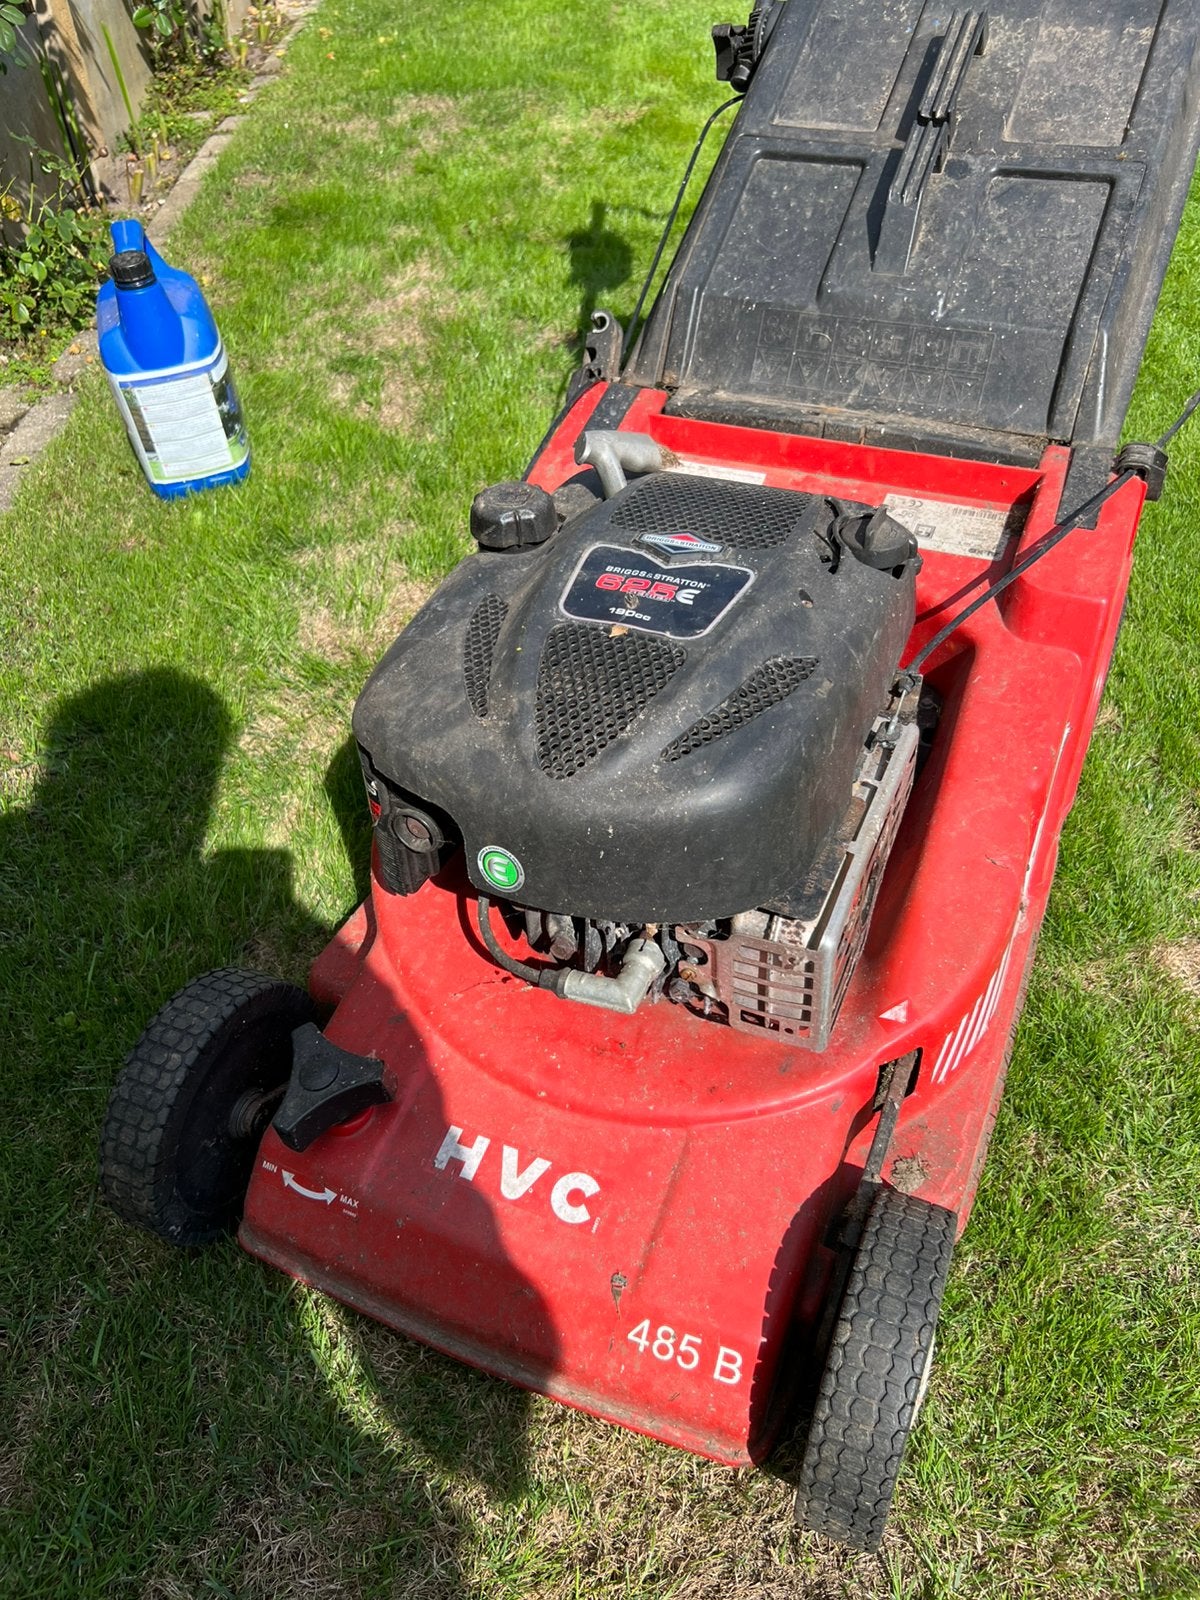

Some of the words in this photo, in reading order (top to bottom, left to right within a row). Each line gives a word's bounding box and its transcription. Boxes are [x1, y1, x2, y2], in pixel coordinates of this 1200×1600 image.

[608, 607, 651, 621] 190cc
[262, 1160, 278, 1173] MIN
[433, 1125, 600, 1224] HVC
[340, 1194, 360, 1209] MAX
[627, 1319, 703, 1370] 485
[713, 1345, 743, 1385] B
